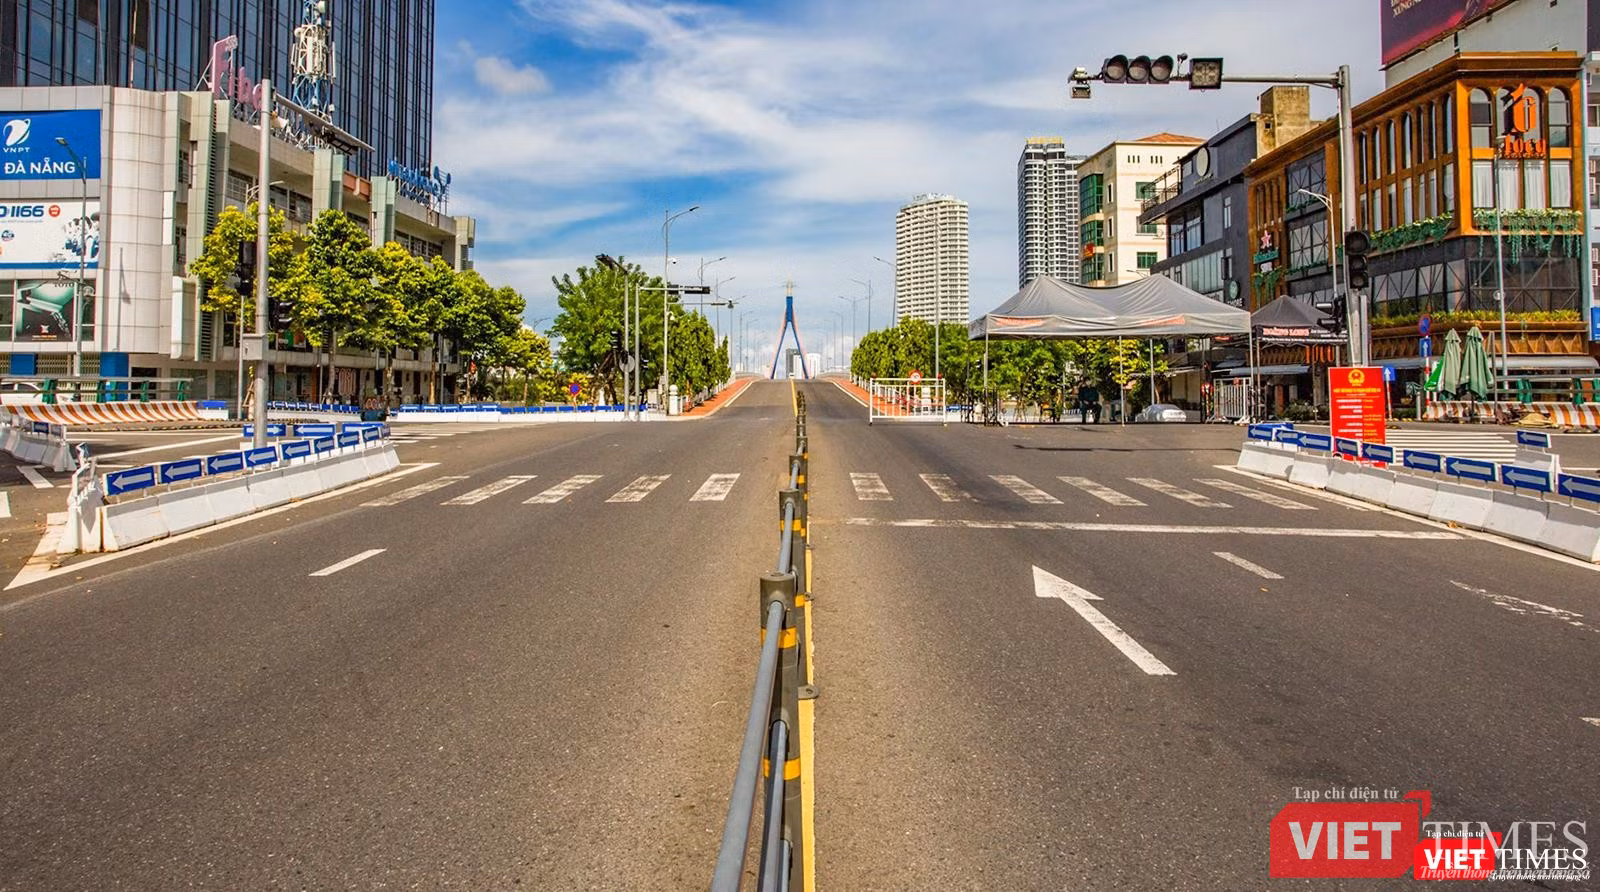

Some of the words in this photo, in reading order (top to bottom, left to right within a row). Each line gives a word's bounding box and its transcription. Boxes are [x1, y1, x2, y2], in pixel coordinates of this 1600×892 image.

[4, 160, 26, 174] ĐÀ
[30, 157, 76, 174] NẴNG
[10, 205, 44, 217] 1166
